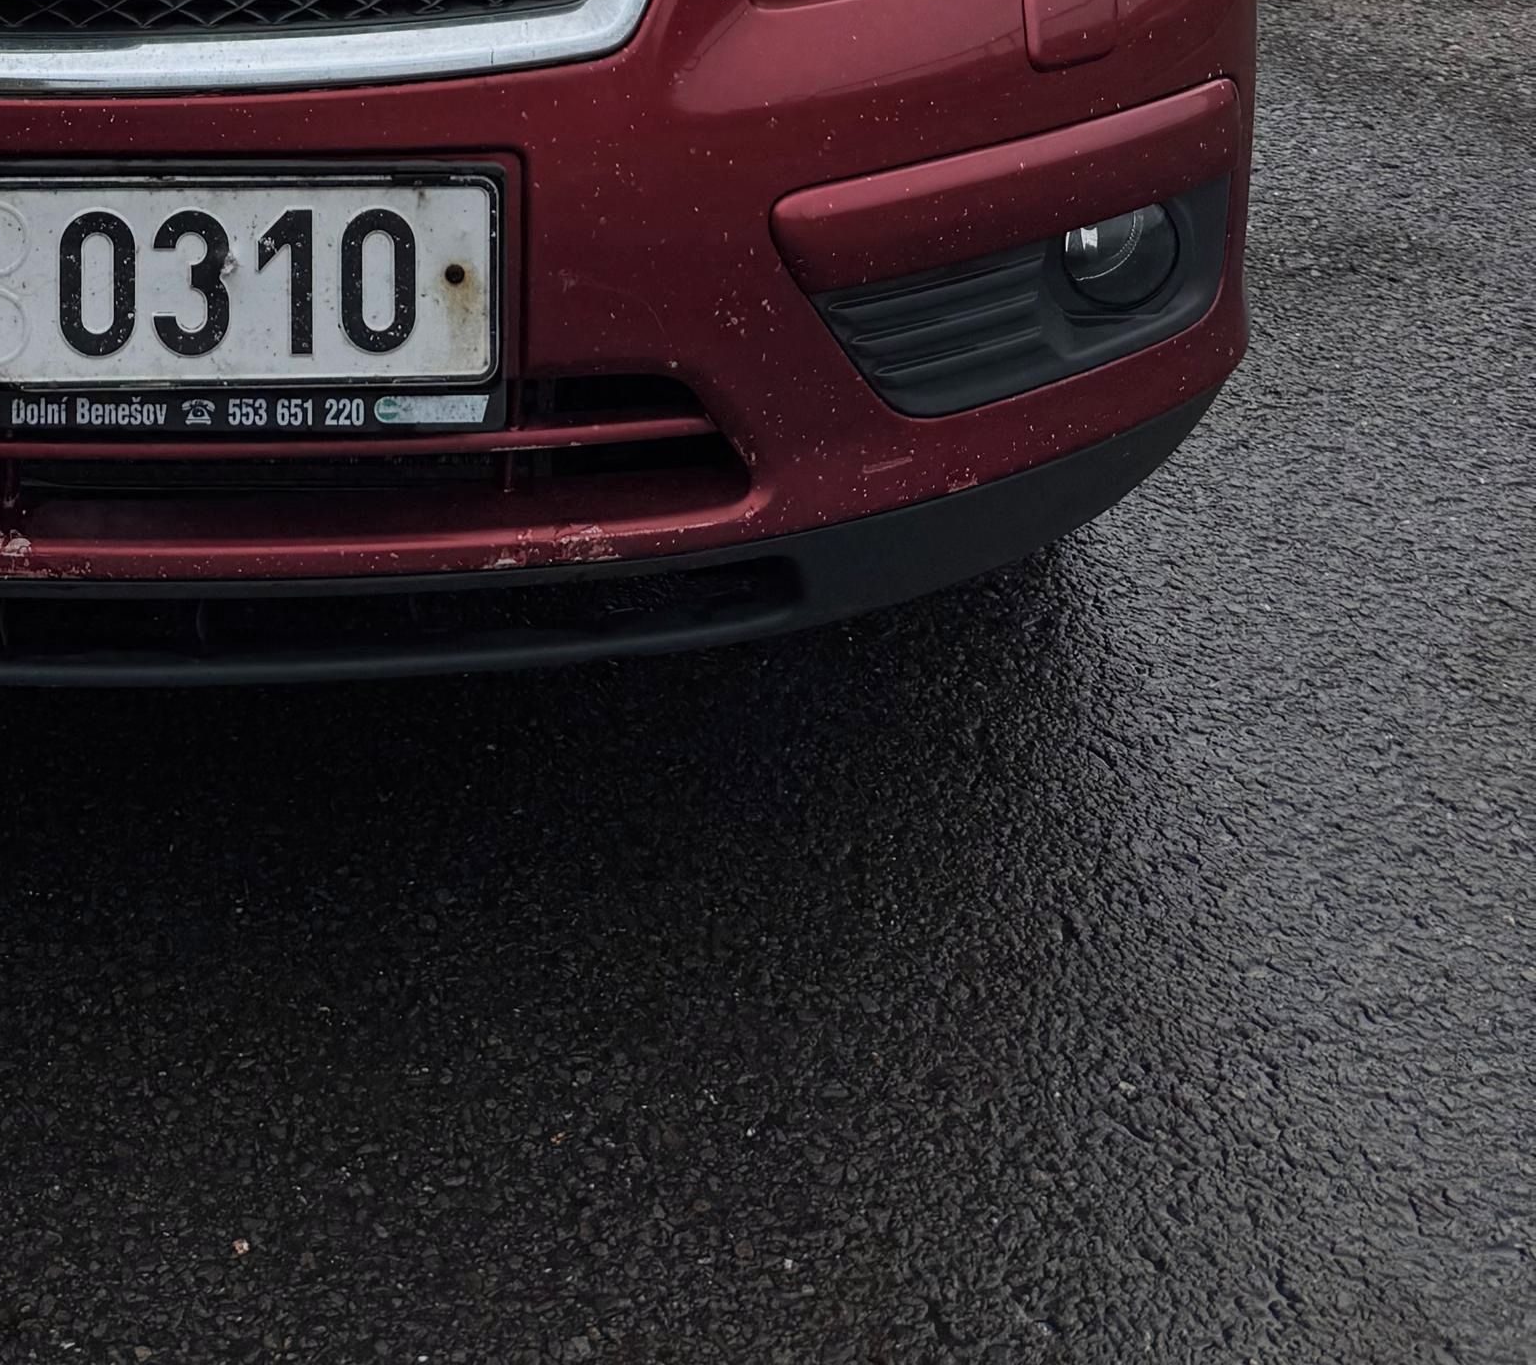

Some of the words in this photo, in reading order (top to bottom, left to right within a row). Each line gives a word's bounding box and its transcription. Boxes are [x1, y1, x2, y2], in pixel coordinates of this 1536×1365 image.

[59, 205, 420, 357] 0310
[75, 396, 168, 426] Benešov
[227, 397, 268, 426] 553
[275, 397, 313, 426] 651
[324, 397, 365, 426] 220
